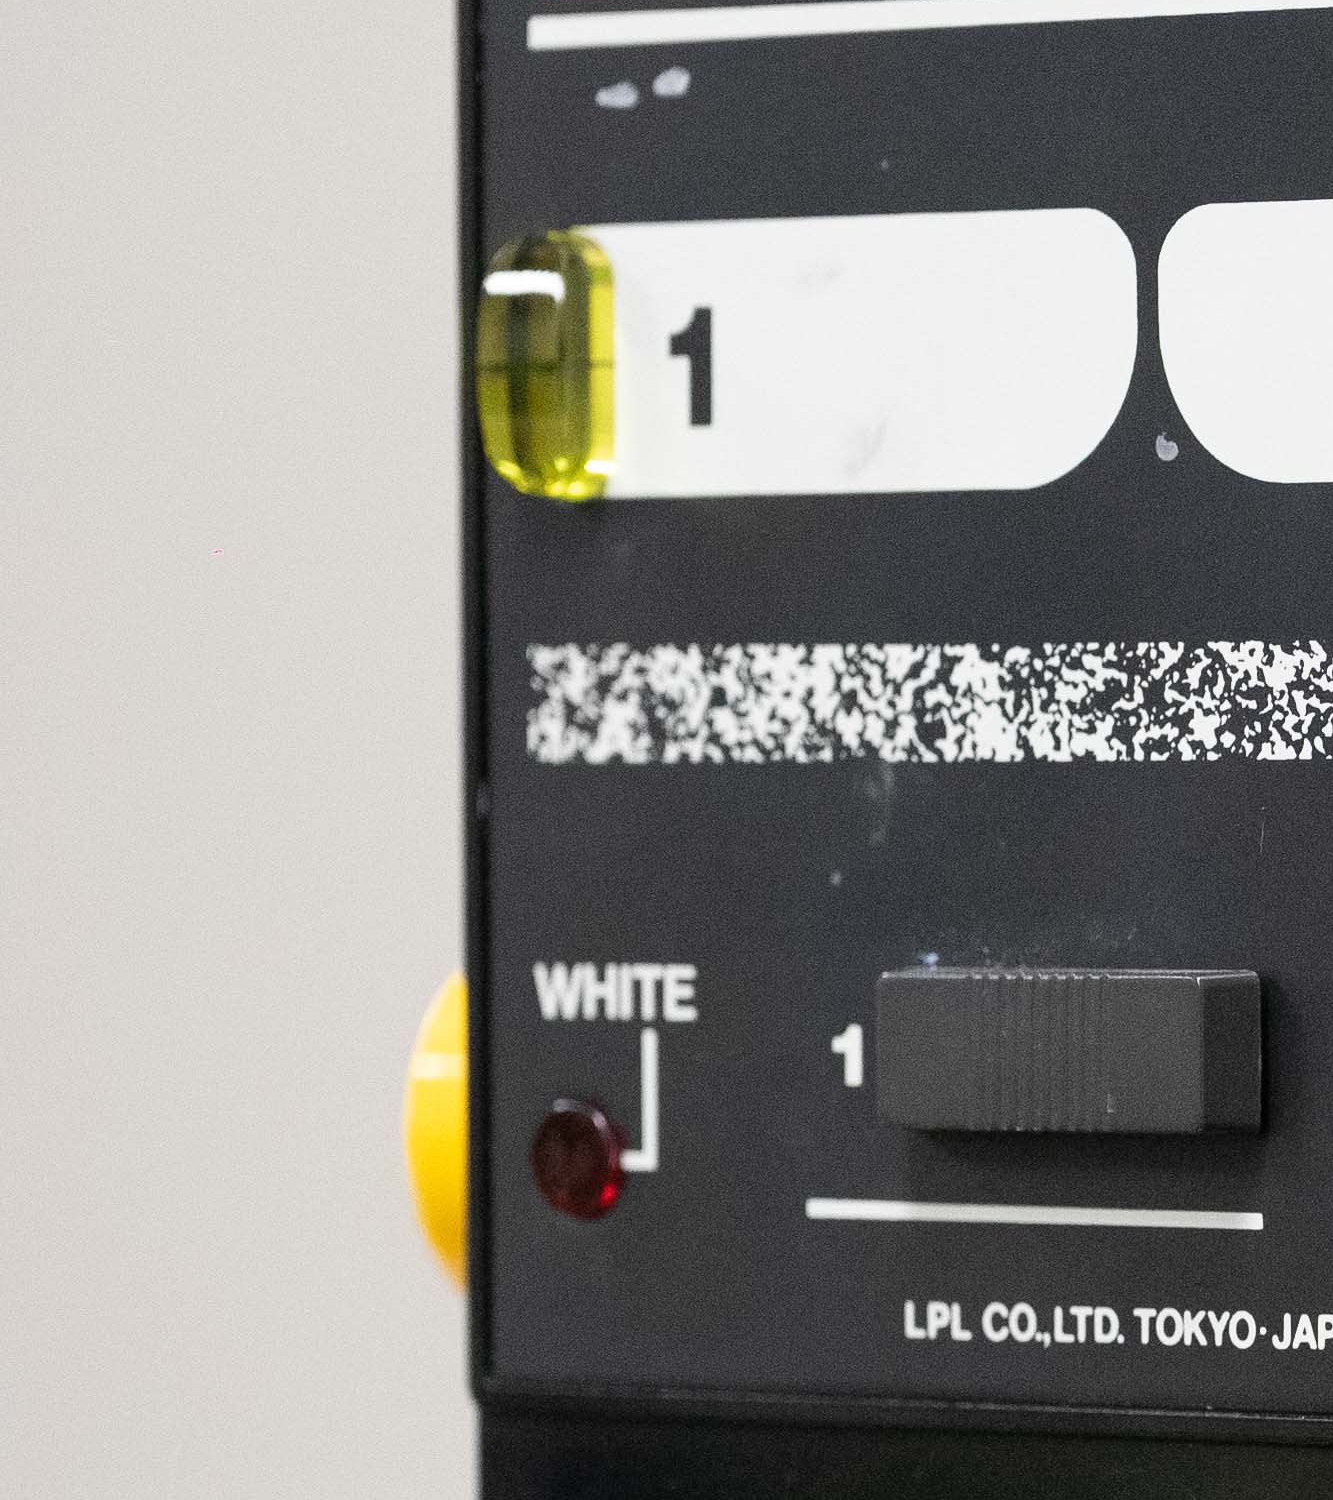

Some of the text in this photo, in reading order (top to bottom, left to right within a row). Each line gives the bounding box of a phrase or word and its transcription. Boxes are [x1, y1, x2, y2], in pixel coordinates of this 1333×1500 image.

[670, 307, 712, 426] 1
[532, 961, 698, 1023] WHITE
[830, 1023, 864, 1088] 1
[903, 1299, 973, 1342] LPL
